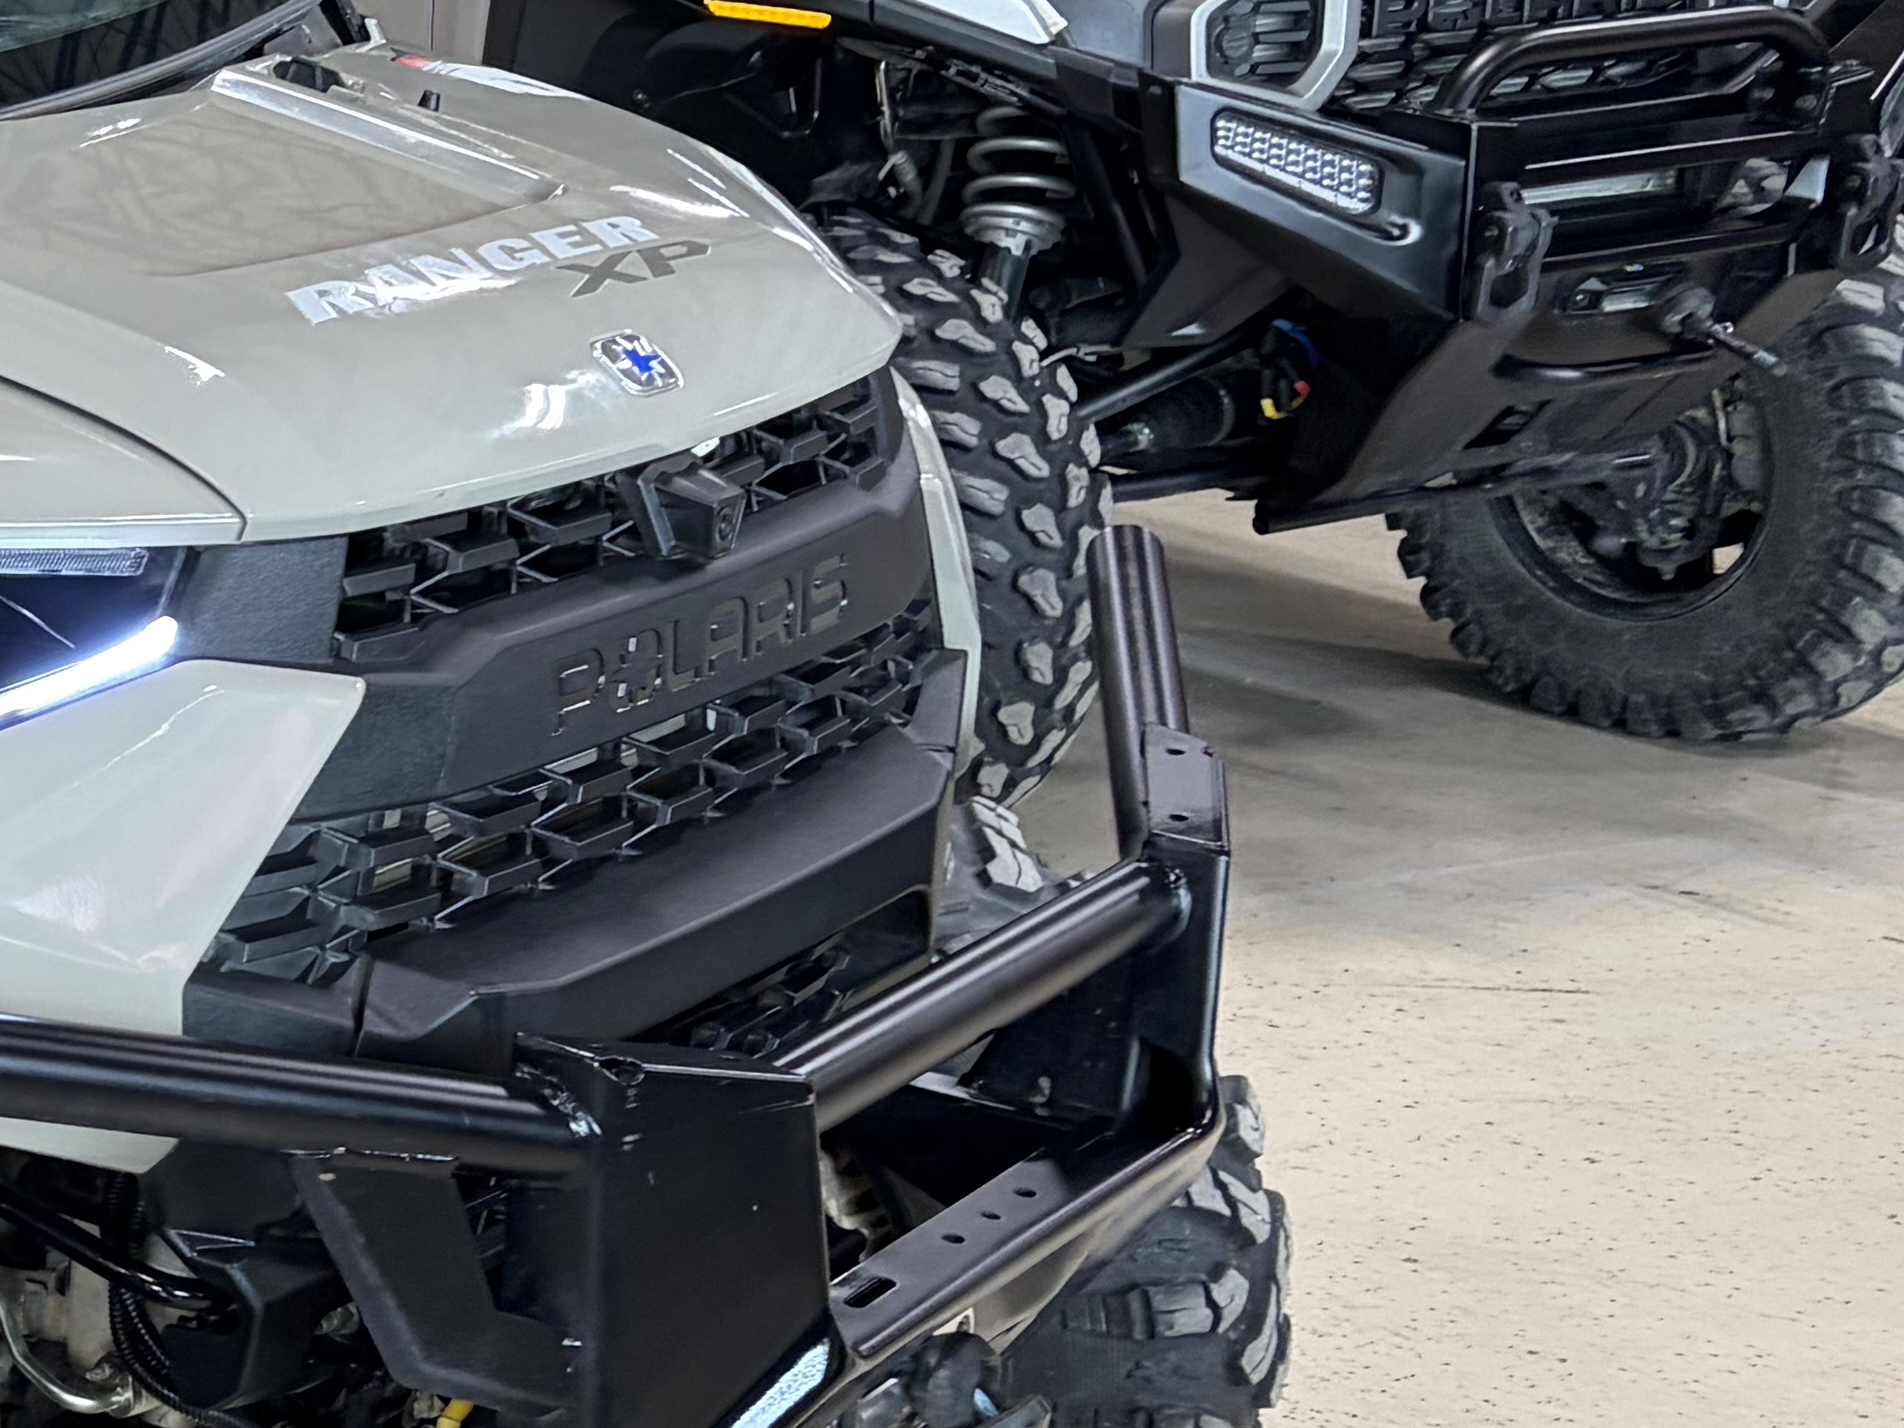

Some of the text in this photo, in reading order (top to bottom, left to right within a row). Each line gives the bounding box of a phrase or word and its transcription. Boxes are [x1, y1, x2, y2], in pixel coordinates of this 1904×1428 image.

[285, 215, 659, 326] RANGER
[556, 240, 711, 299] XP
[550, 552, 848, 737] POLARIS
